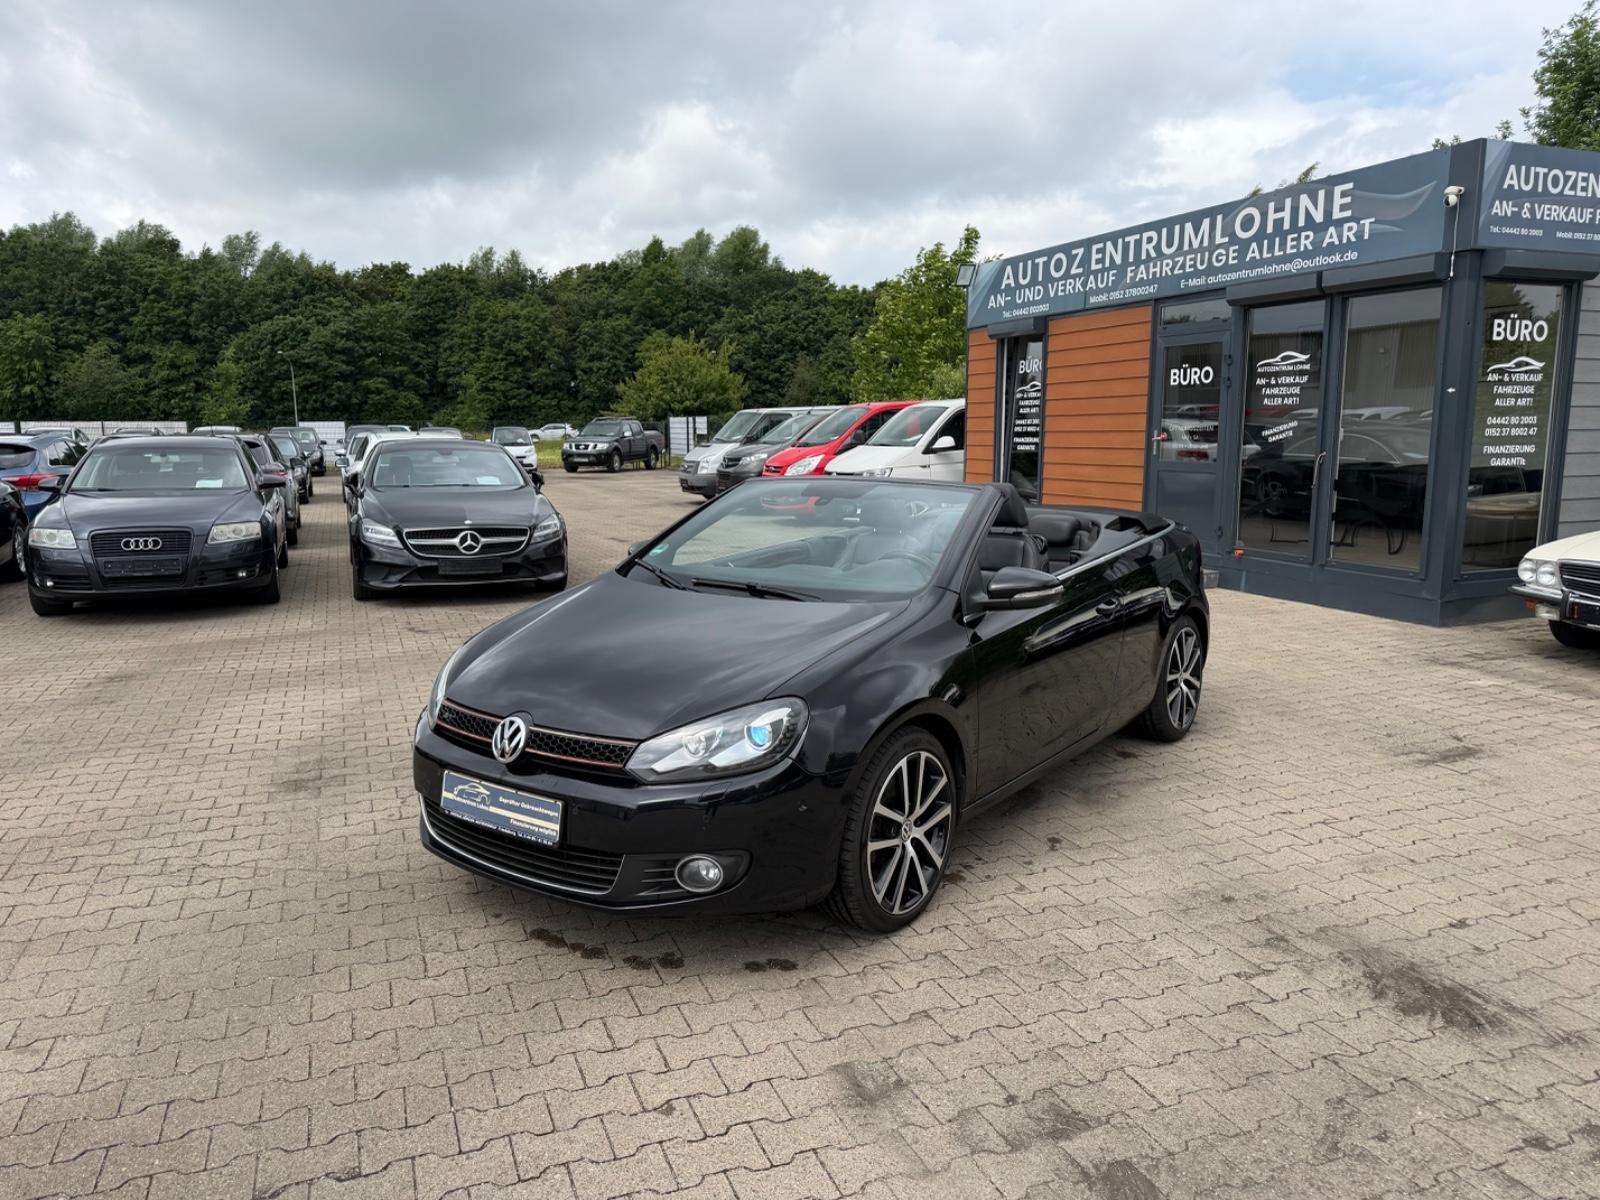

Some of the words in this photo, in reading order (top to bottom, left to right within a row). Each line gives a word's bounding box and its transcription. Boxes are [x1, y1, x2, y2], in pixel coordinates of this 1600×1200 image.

[1503, 164, 1600, 198] AUTOZEN
[1491, 200, 1518, 217] AN-
[1521, 202, 1531, 219] &
[1534, 203, 1594, 224] VERKAUF
[988, 292, 1011, 309] AN-
[1015, 285, 1044, 304] UND
[1048, 270, 1117, 299] VERKAUF
[1125, 245, 1239, 284] FAHRZEUGE
[1245, 231, 1314, 262] ALLER
[1322, 217, 1376, 248] ART
[1207, 250, 1359, 285] autozentrumlohne@outlook.de
[1492, 313, 1548, 342] BÜRO
[1019, 355, 1042, 374] BÜR
[1170, 364, 1214, 386] BÜRO
[1256, 378, 1270, 386] AN-
[1278, 375, 1309, 384] VERKAUF
[1487, 373, 1502, 382] AN-
[1503, 373, 1510, 382] &
[1511, 373, 1544, 382] VERKAUF
[1261, 386, 1301, 395] FAHRZEUGE
[1493, 385, 1535, 394] FAHRZEUGE
[1263, 397, 1282, 405] ALLER
[1283, 397, 1300, 405] ART!
[1494, 398, 1516, 406] ALLER
[1516, 397, 1533, 406] ART!
[1486, 416, 1510, 425] 04442
[1510, 415, 1520, 424] 80
[1520, 415, 1537, 424] 2003
[1484, 428, 1501, 437] 0152
[1501, 428, 1510, 436] 37
[1510, 427, 1528, 436] 8002
[1528, 426, 1538, 435] 47
[1483, 445, 1536, 454] FINANZIERUNG
